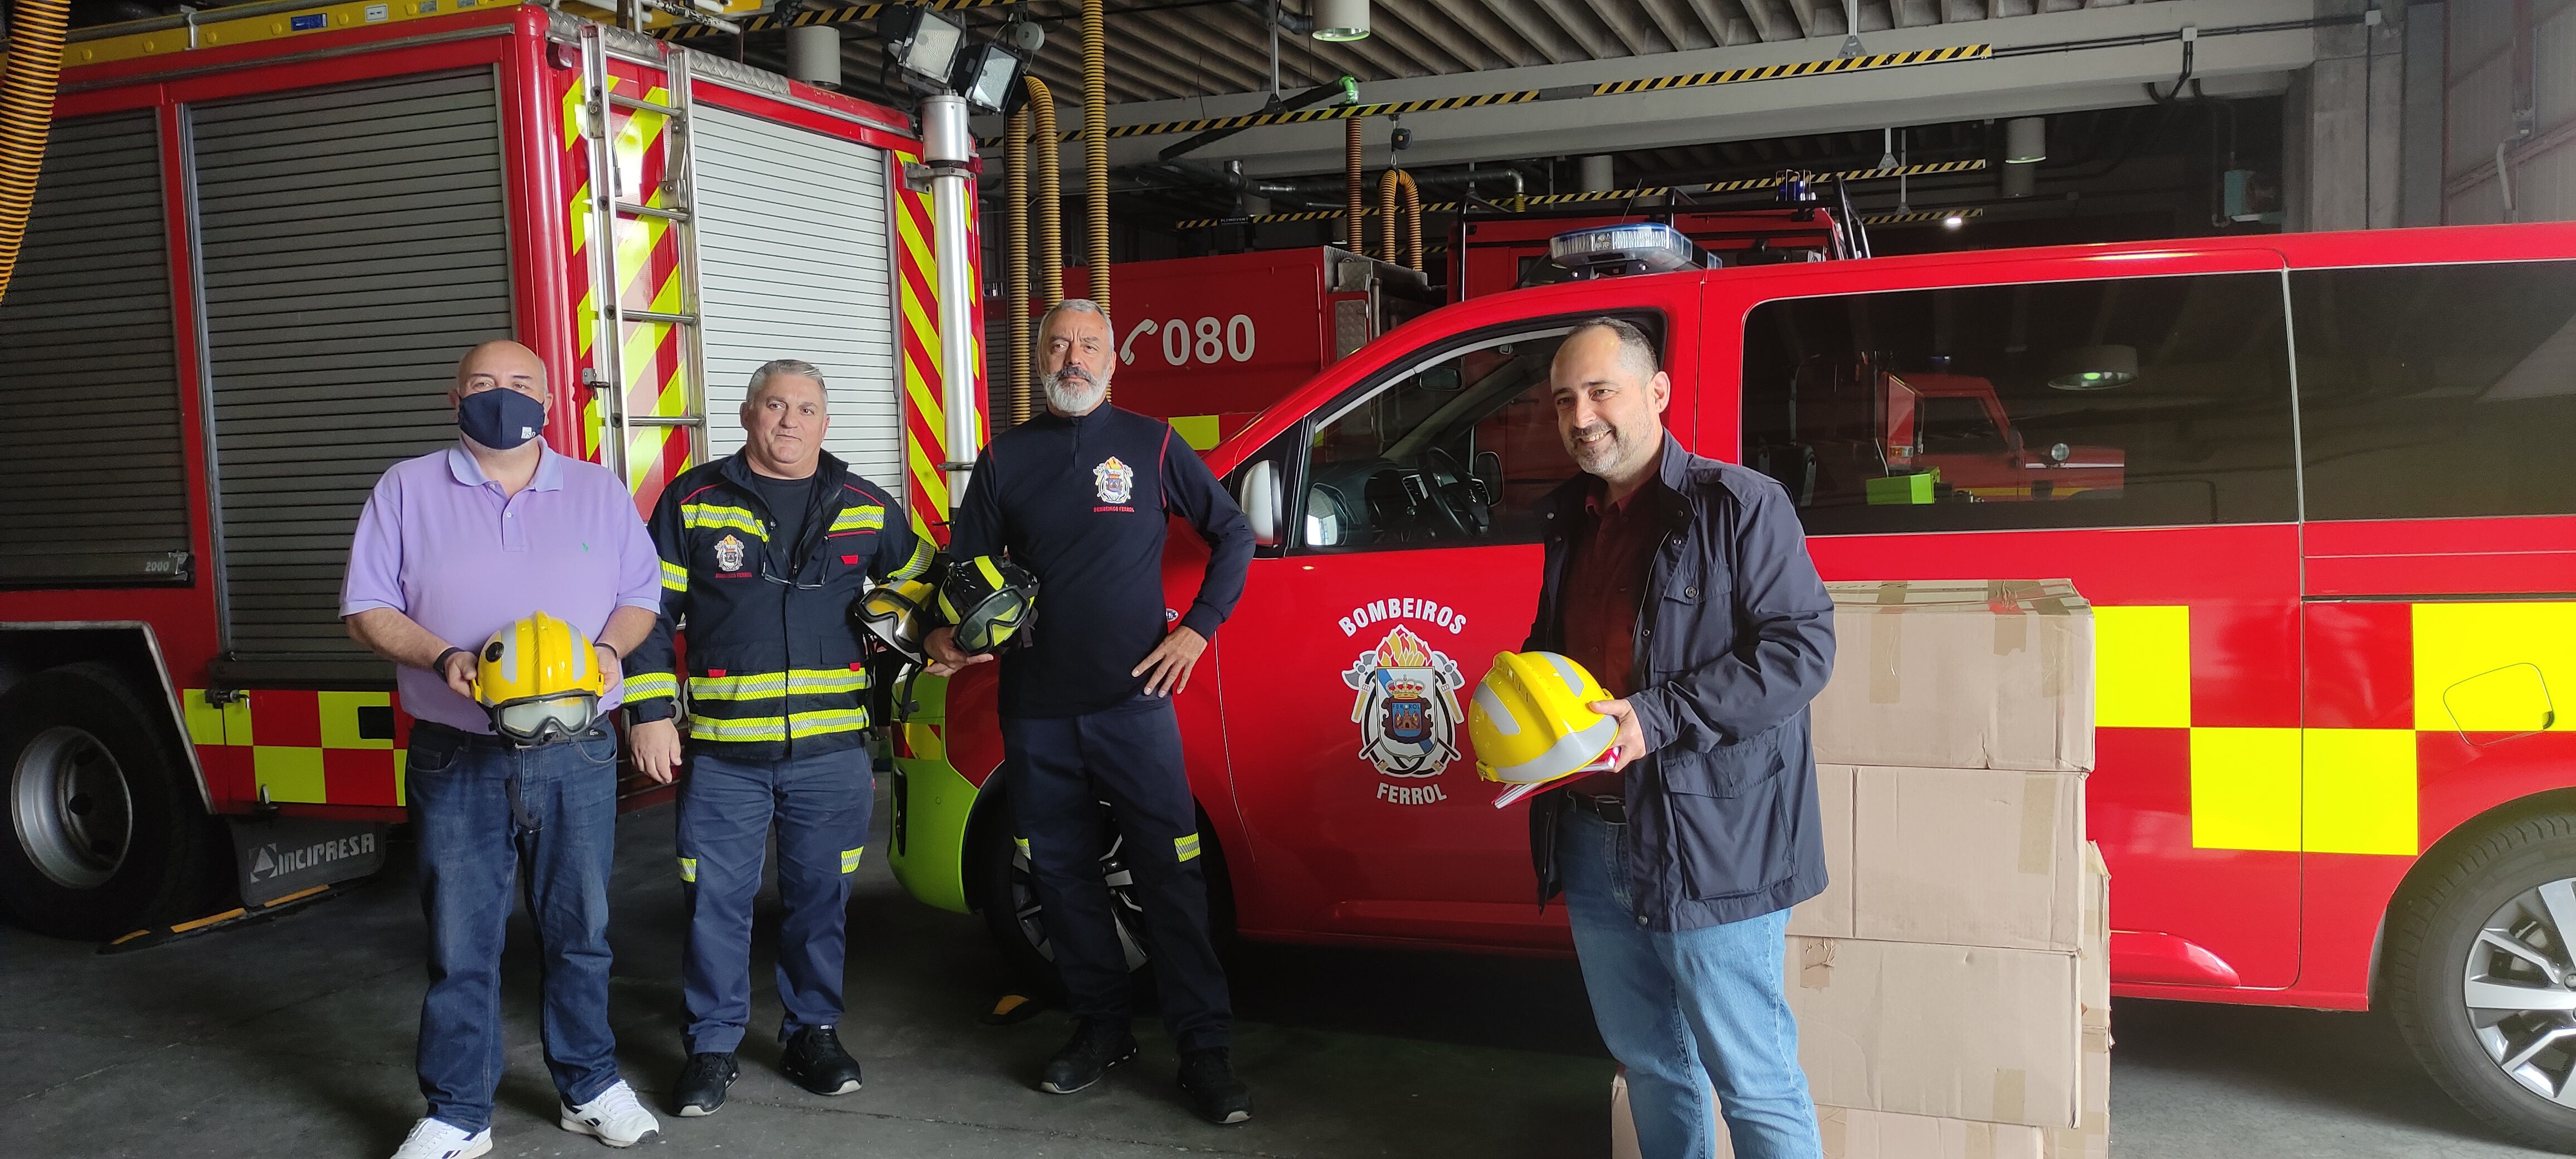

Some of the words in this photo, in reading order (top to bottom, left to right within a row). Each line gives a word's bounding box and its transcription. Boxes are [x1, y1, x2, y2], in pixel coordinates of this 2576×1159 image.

[1162, 314, 1255, 366] 080
[145, 561, 170, 572] 2000
[1338, 597, 1467, 637] BOMBEIROS
[1376, 782, 1448, 805] FERROL
